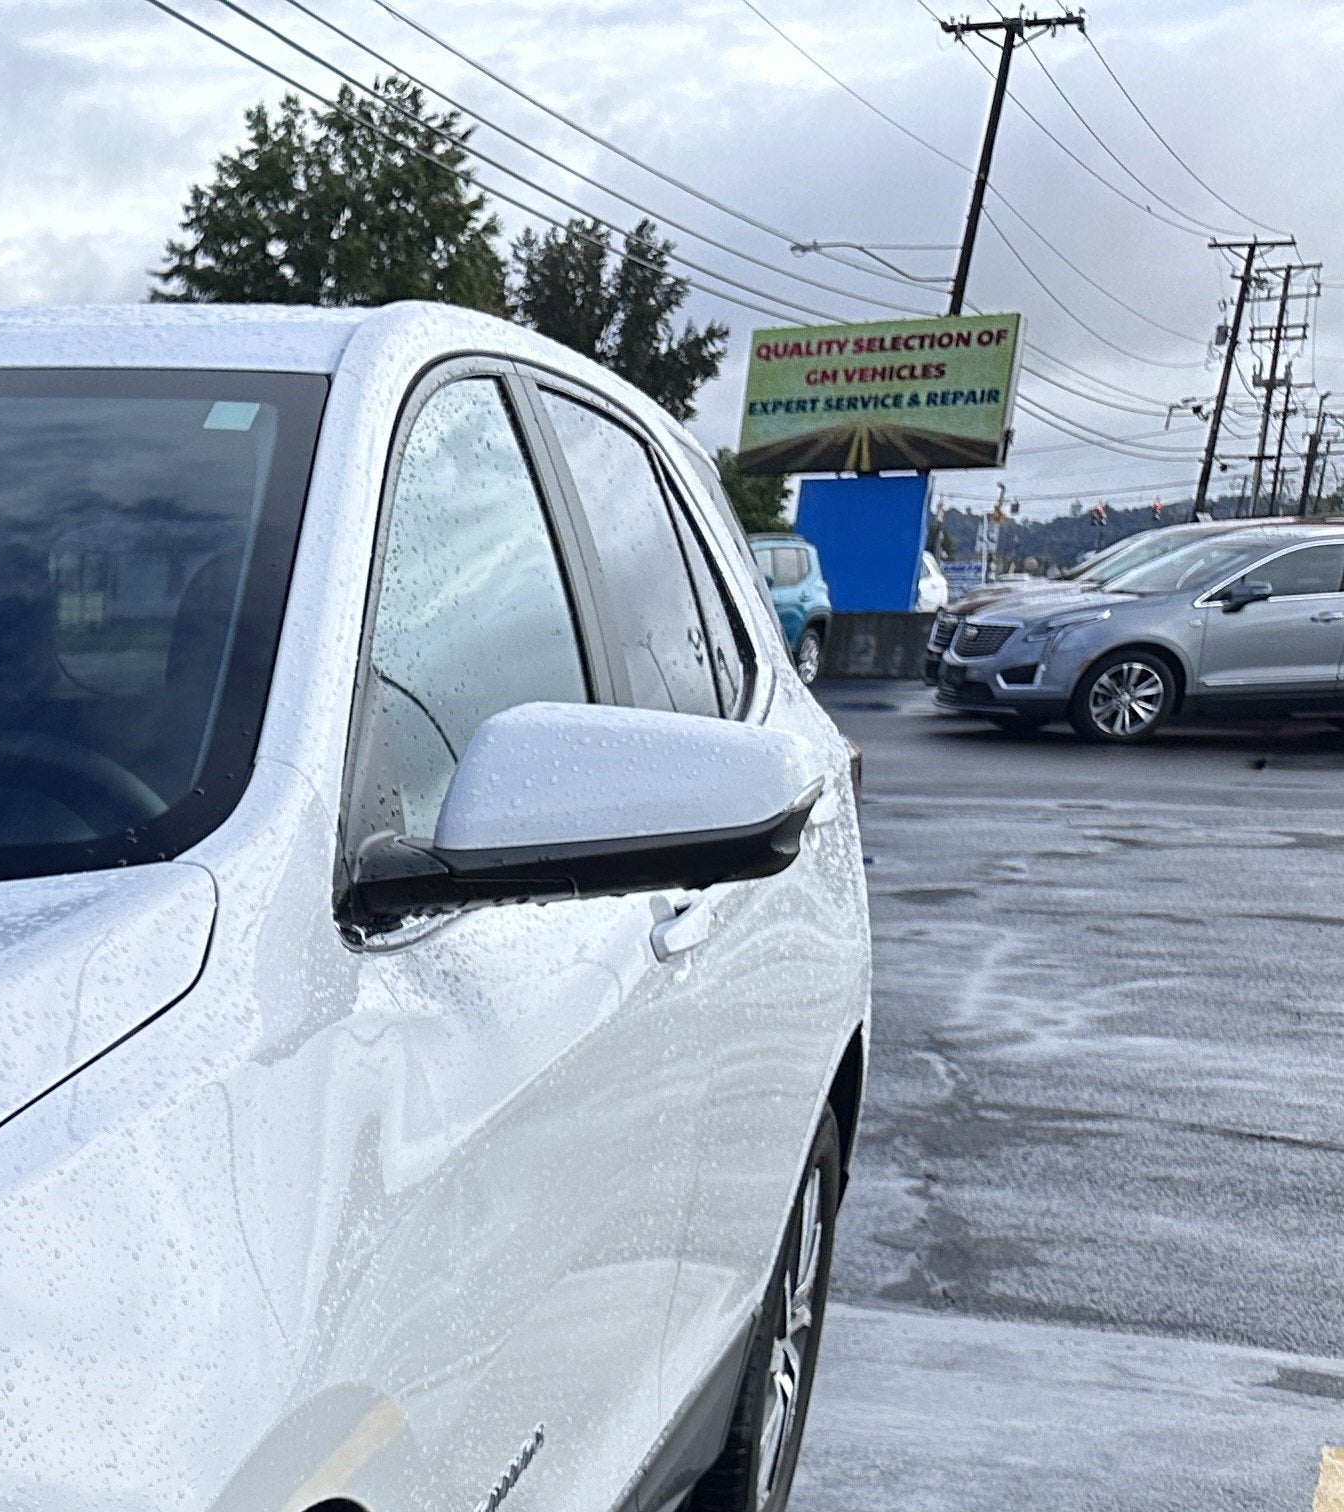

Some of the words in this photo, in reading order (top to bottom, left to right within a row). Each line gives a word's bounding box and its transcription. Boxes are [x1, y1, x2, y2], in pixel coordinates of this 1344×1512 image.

[755, 338, 848, 362] QUALITY
[852, 330, 972, 355] SELECTION
[977, 328, 1009, 347] OF
[805, 368, 839, 386] GM
[844, 362, 947, 384] VEHICLES
[748, 397, 821, 417] EXPERT
[824, 393, 903, 412] SERVICE
[907, 391, 921, 408] &
[925, 387, 1001, 407] REPAIR
